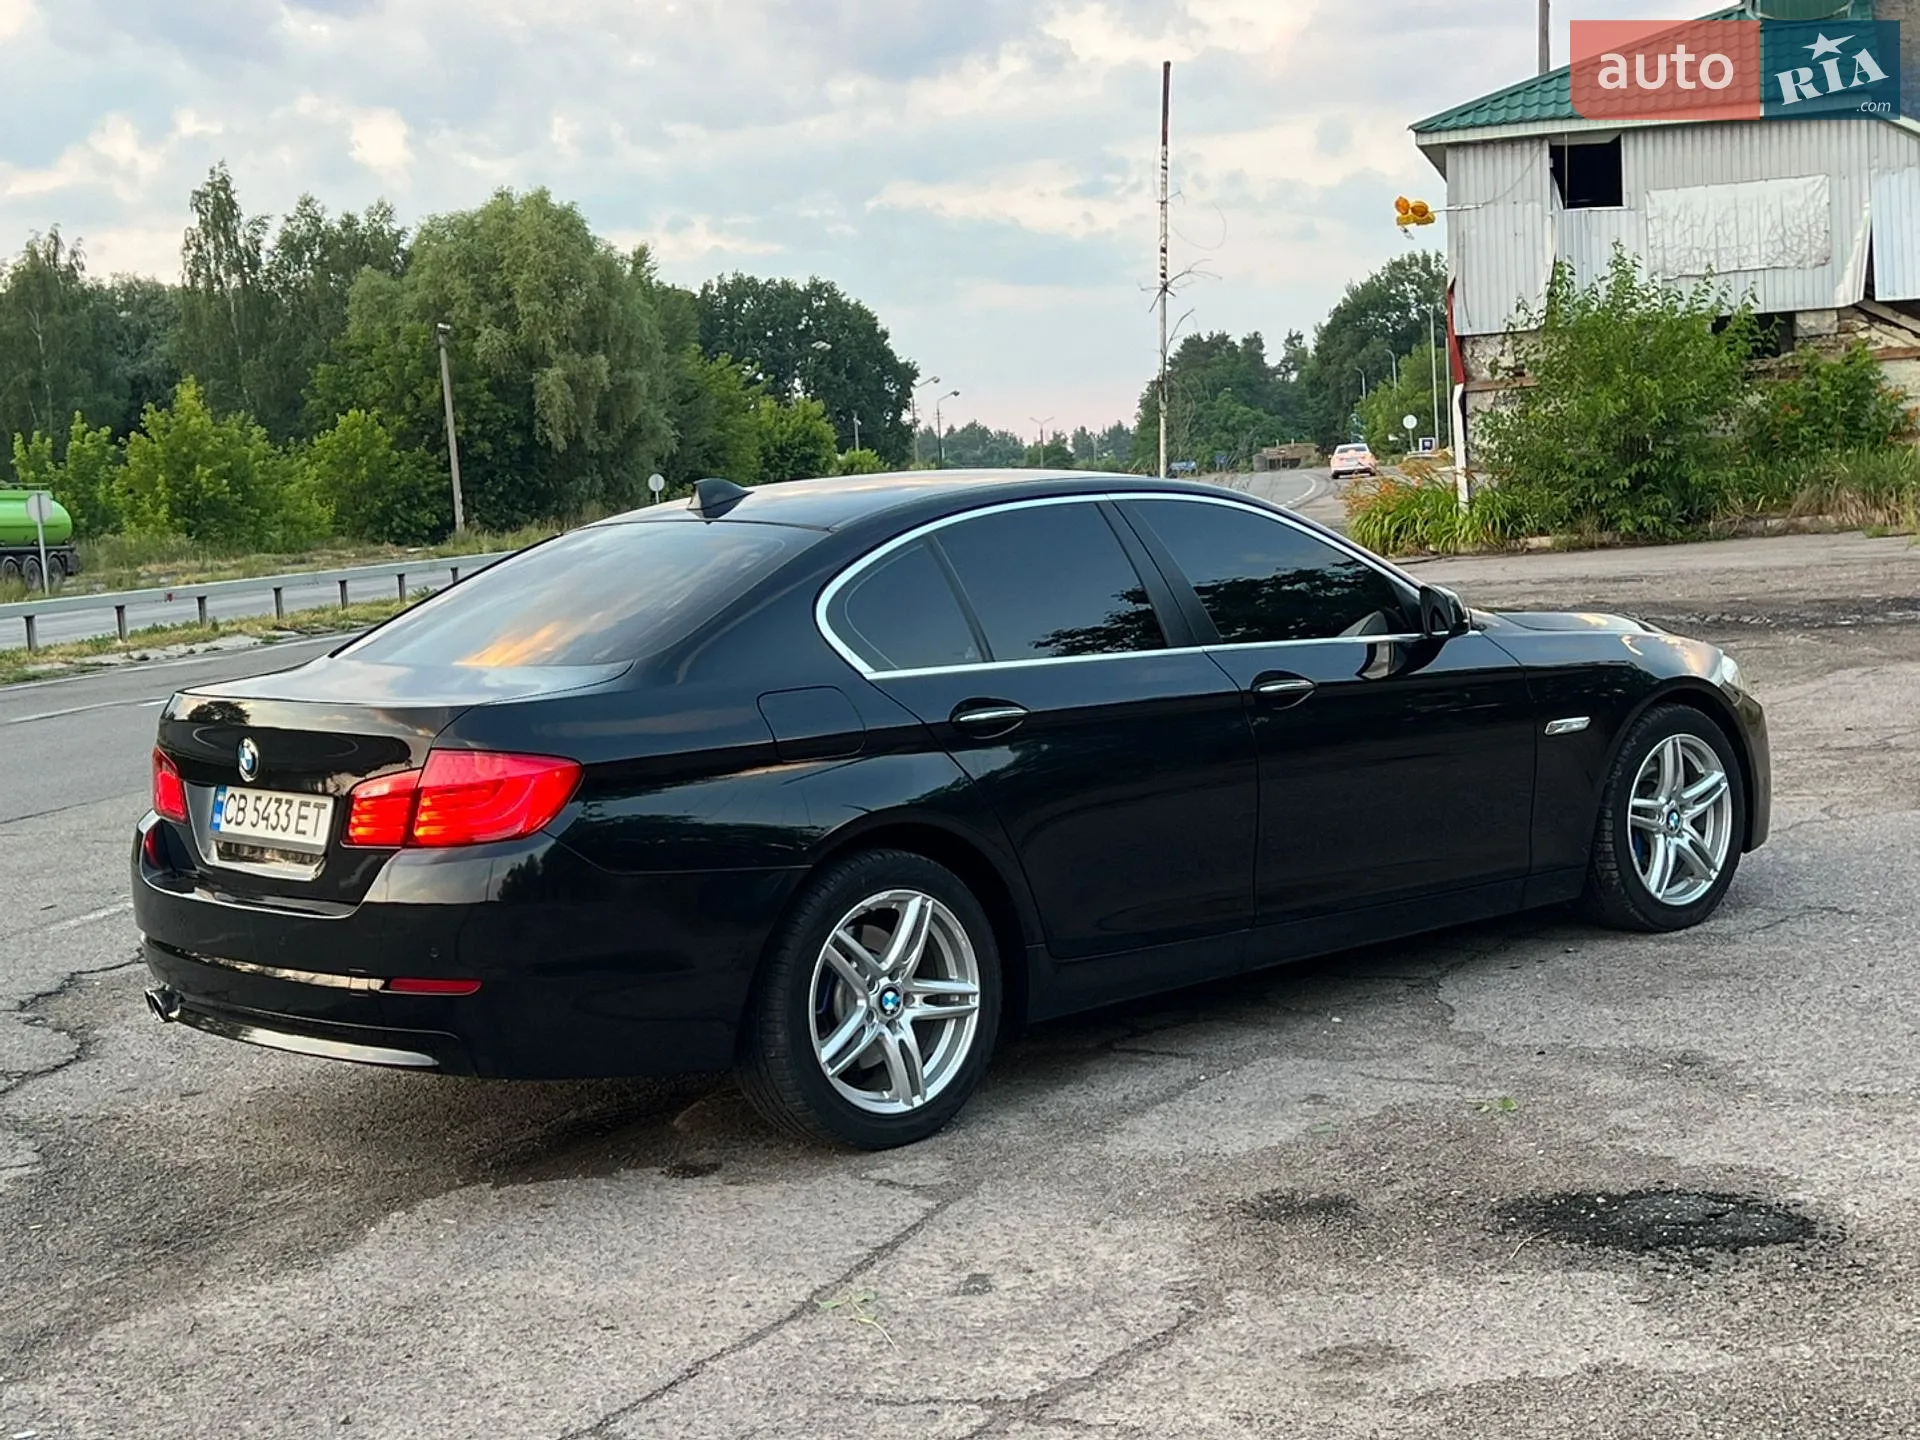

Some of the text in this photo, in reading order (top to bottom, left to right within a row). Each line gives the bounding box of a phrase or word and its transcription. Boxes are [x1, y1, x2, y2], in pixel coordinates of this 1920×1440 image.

[225, 793, 327, 837] CB 5433 ET
